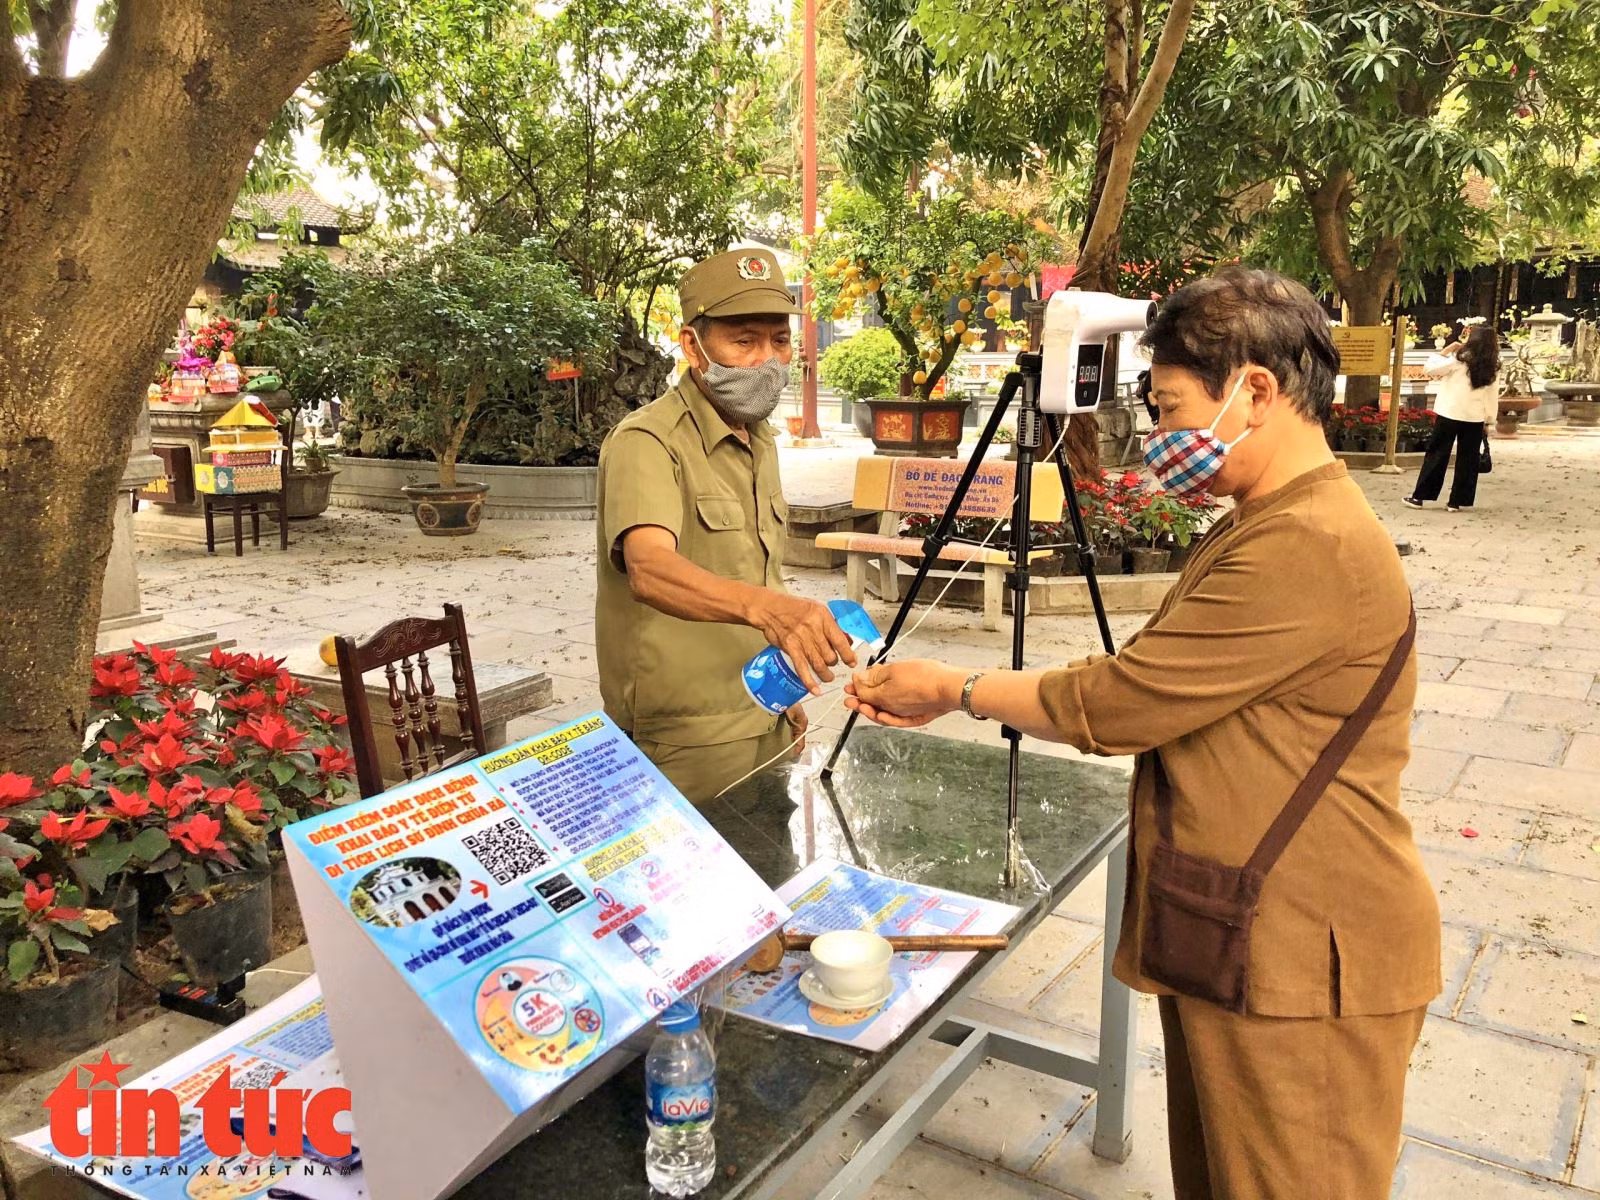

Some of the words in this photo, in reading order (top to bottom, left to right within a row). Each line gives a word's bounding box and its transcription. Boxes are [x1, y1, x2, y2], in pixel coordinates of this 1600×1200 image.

[973, 472, 1003, 485] RÀNG
[529, 740, 553, 753] KHAI
[536, 745, 574, 764] QR-CODE
[308, 824, 348, 846] ĐIỂM
[345, 810, 384, 831] KIỂM
[380, 798, 416, 818] SOÁT
[413, 787, 446, 806] DỊCH
[442, 774, 479, 794] BỆNH
[336, 833, 373, 854] KHAI
[370, 822, 401, 841] BÁO
[398, 819, 411, 830] Y
[408, 811, 429, 826] TẾ
[426, 799, 459, 819] ĐIỆN
[456, 792, 478, 806] TỬ
[325, 864, 344, 879] DI
[342, 851, 377, 871] TÍCH
[376, 838, 408, 858] LỊCH
[423, 818, 458, 838] ĐÌNH
[454, 805, 489, 825] CHÙA
[486, 797, 506, 811] HÀ
[521, 993, 549, 1017] 5K
[662, 1098, 710, 1117] laVie
